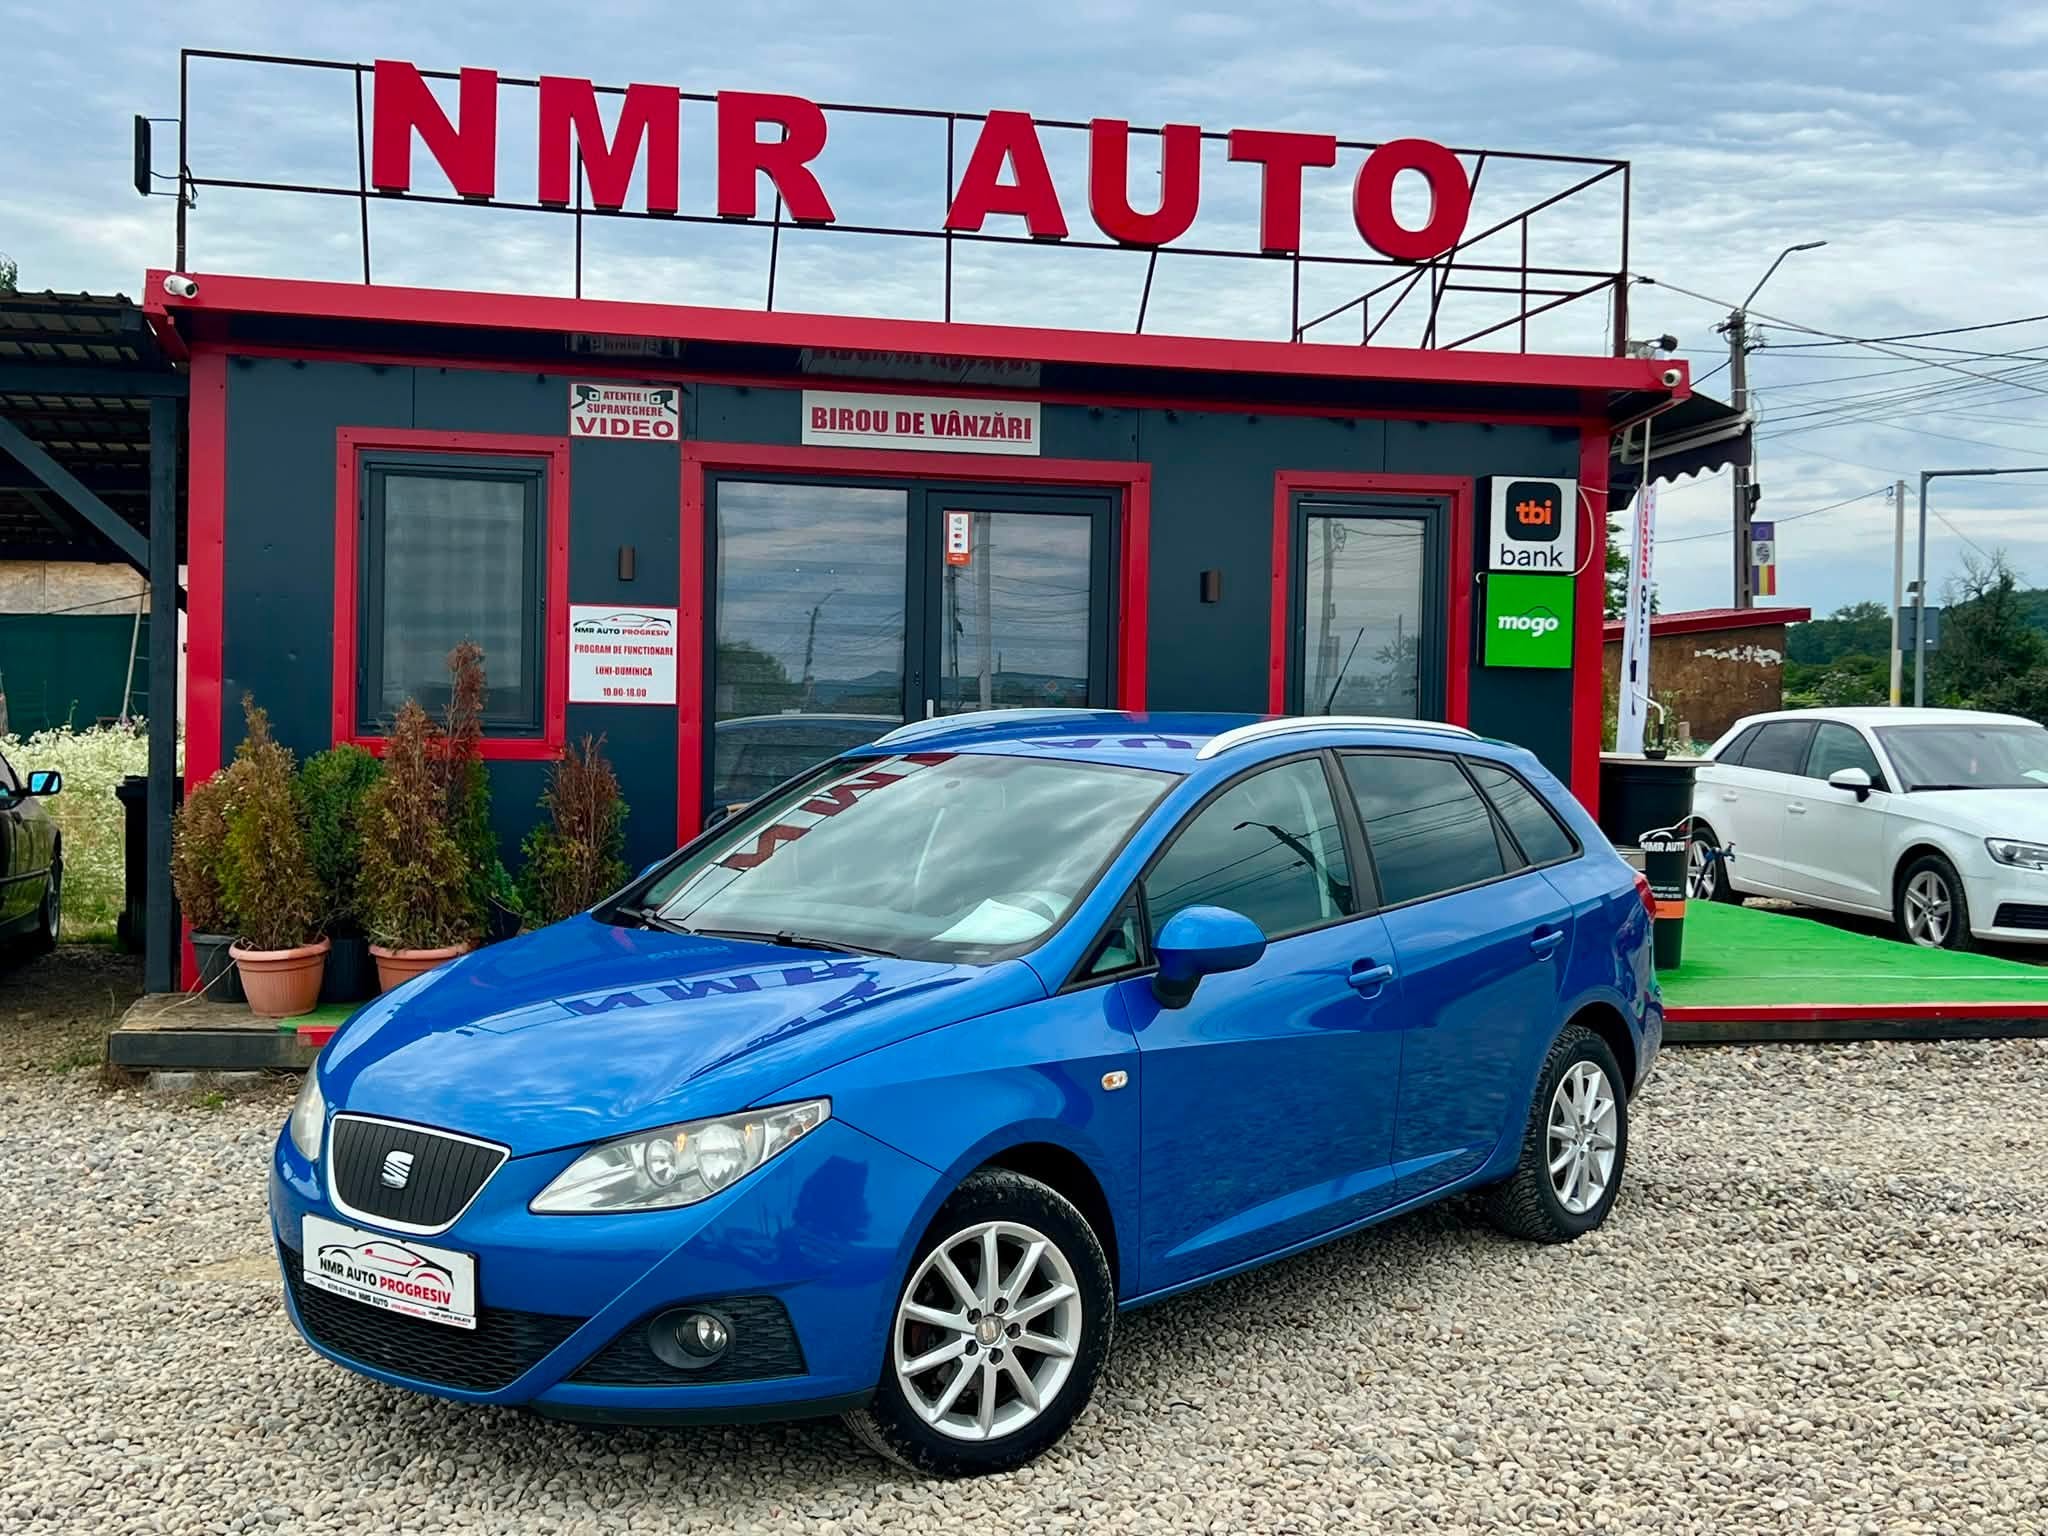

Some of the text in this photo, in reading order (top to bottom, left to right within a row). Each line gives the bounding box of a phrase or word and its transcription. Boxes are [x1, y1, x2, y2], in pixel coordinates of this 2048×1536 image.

[372, 59, 1471, 262] NMR AUTO
[587, 403, 663, 416] SUPRAVEGHERE
[576, 416, 674, 437] VIDEO
[811, 406, 1032, 440] BIROU DE VÂNZĂRI
[1515, 499, 1552, 525] tbi
[1500, 543, 1564, 567] bank
[1497, 615, 1559, 638] mogo
[574, 643, 611, 654] PROGRAM
[613, 645, 622, 654] DE
[595, 666, 653, 676] LUNI-DUMINICA
[319, 1257, 344, 1277] NMR
[346, 1266, 377, 1286] AUTO
[379, 1275, 452, 1305] PROGRESIV
